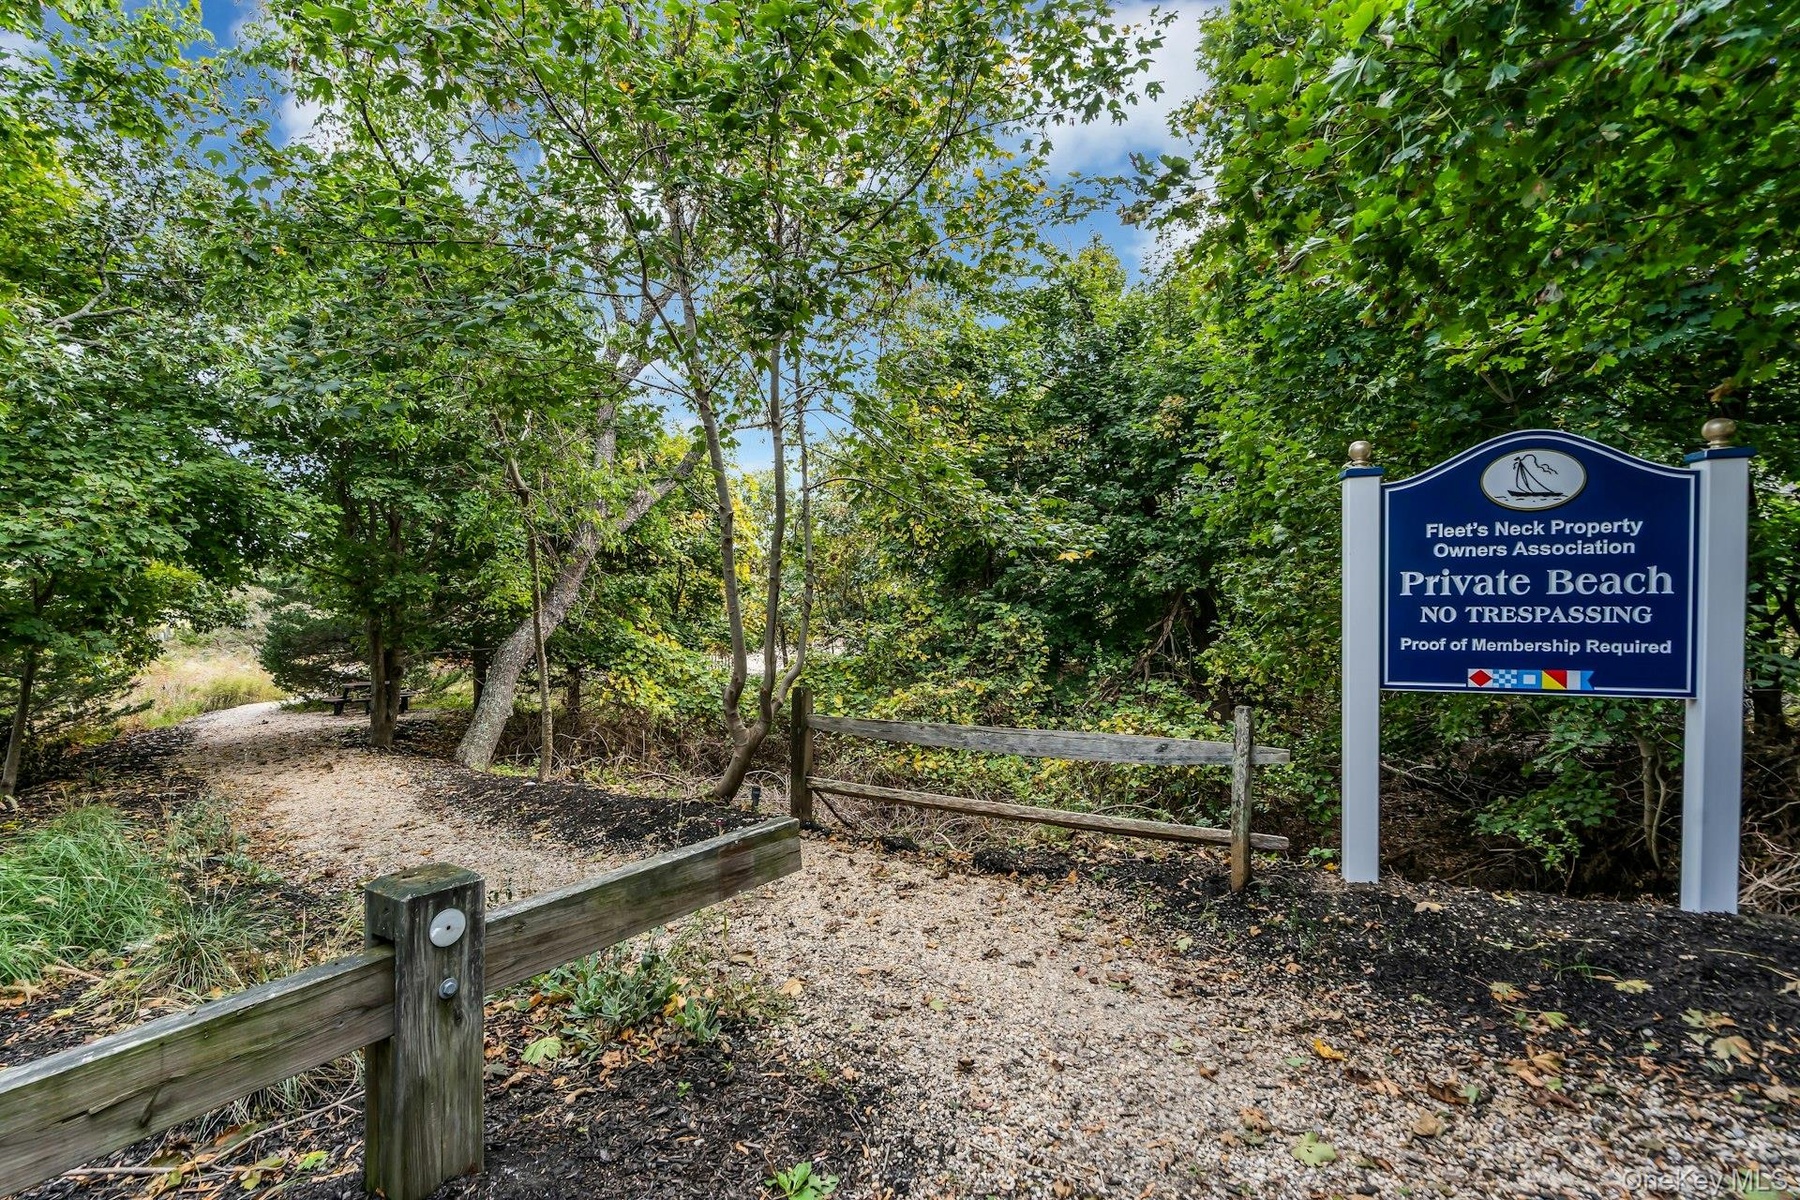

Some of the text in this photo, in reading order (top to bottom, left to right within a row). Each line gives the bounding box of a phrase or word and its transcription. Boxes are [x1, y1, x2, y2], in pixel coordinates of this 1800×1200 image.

[1425, 518, 1644, 538] Fleet's Neck Property
[1433, 539, 1636, 558] Owners Association
[1399, 565, 1675, 597] Private Beach
[1420, 606, 1653, 625] NO TRESPASSING
[1400, 637, 1673, 656] Proof of Membership Required
